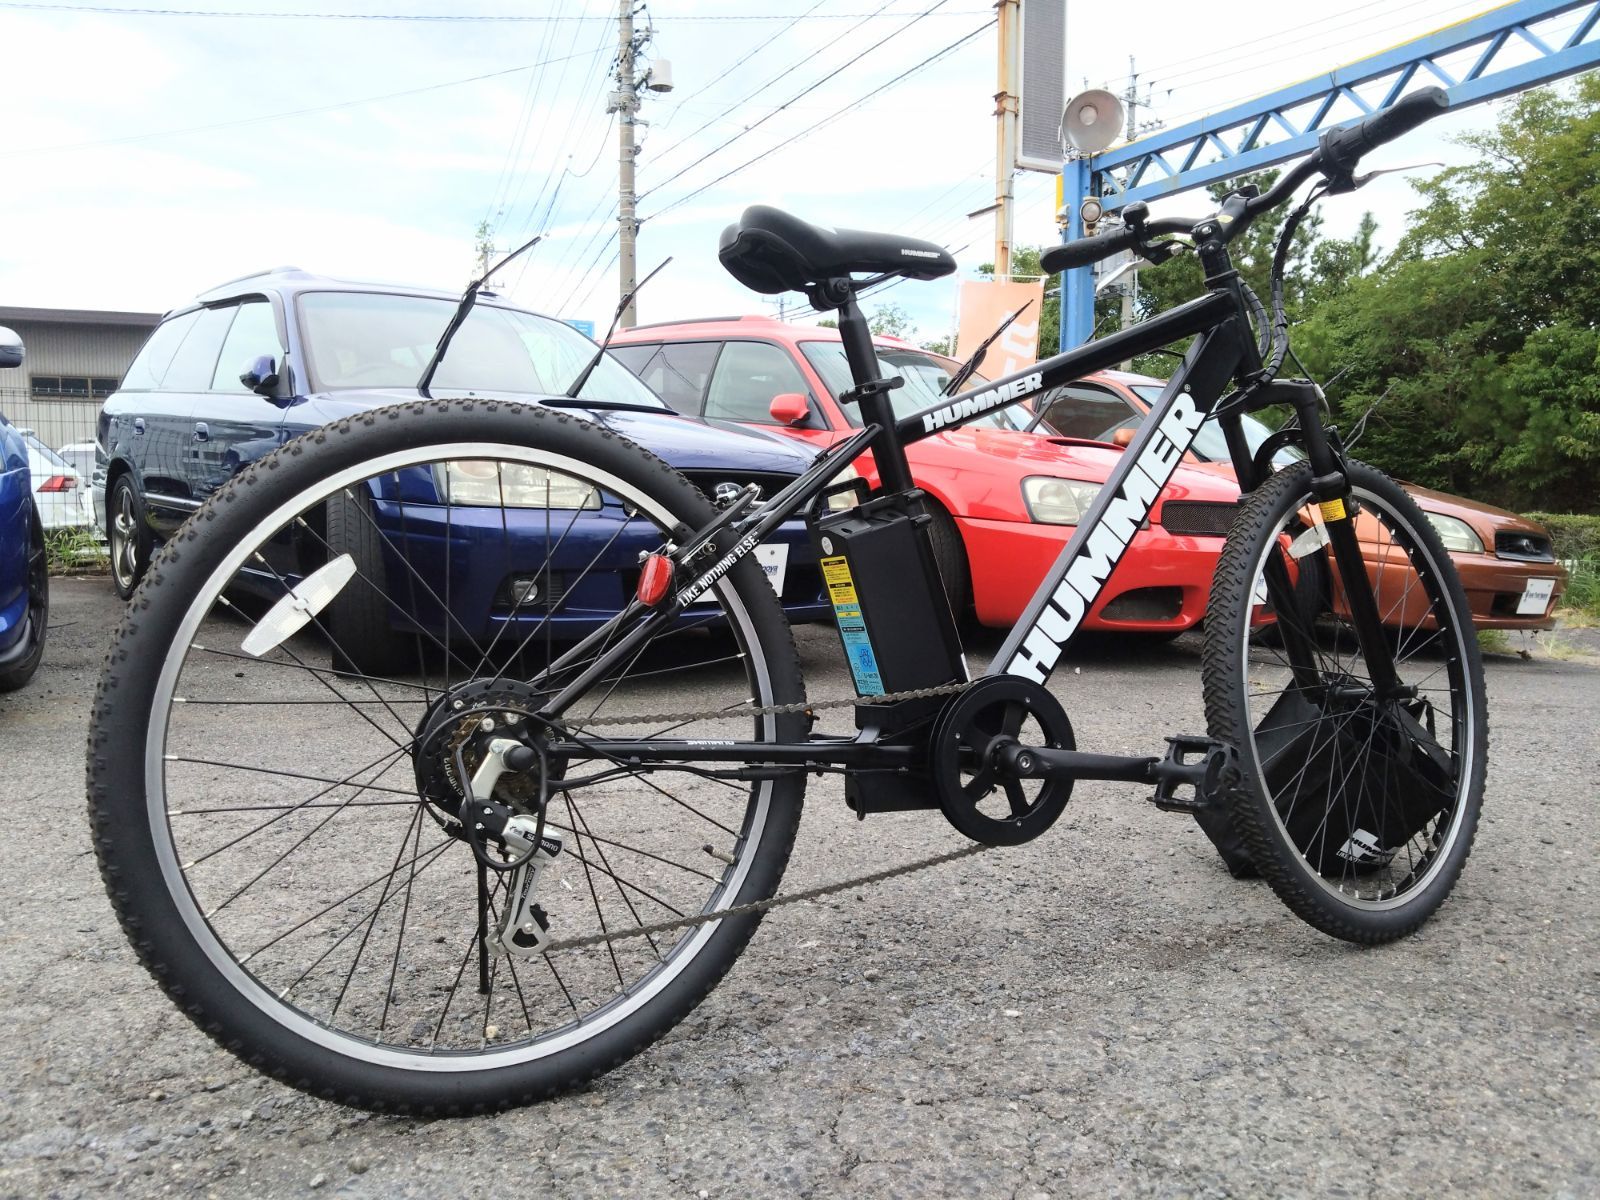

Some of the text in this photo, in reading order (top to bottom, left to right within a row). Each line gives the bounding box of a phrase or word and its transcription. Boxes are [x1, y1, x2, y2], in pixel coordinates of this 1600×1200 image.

[922, 372, 1043, 433] HUMMER
[1006, 392, 1207, 686] HUMMER
[679, 585, 701, 608] LIKE
[699, 553, 738, 591] NOTHING
